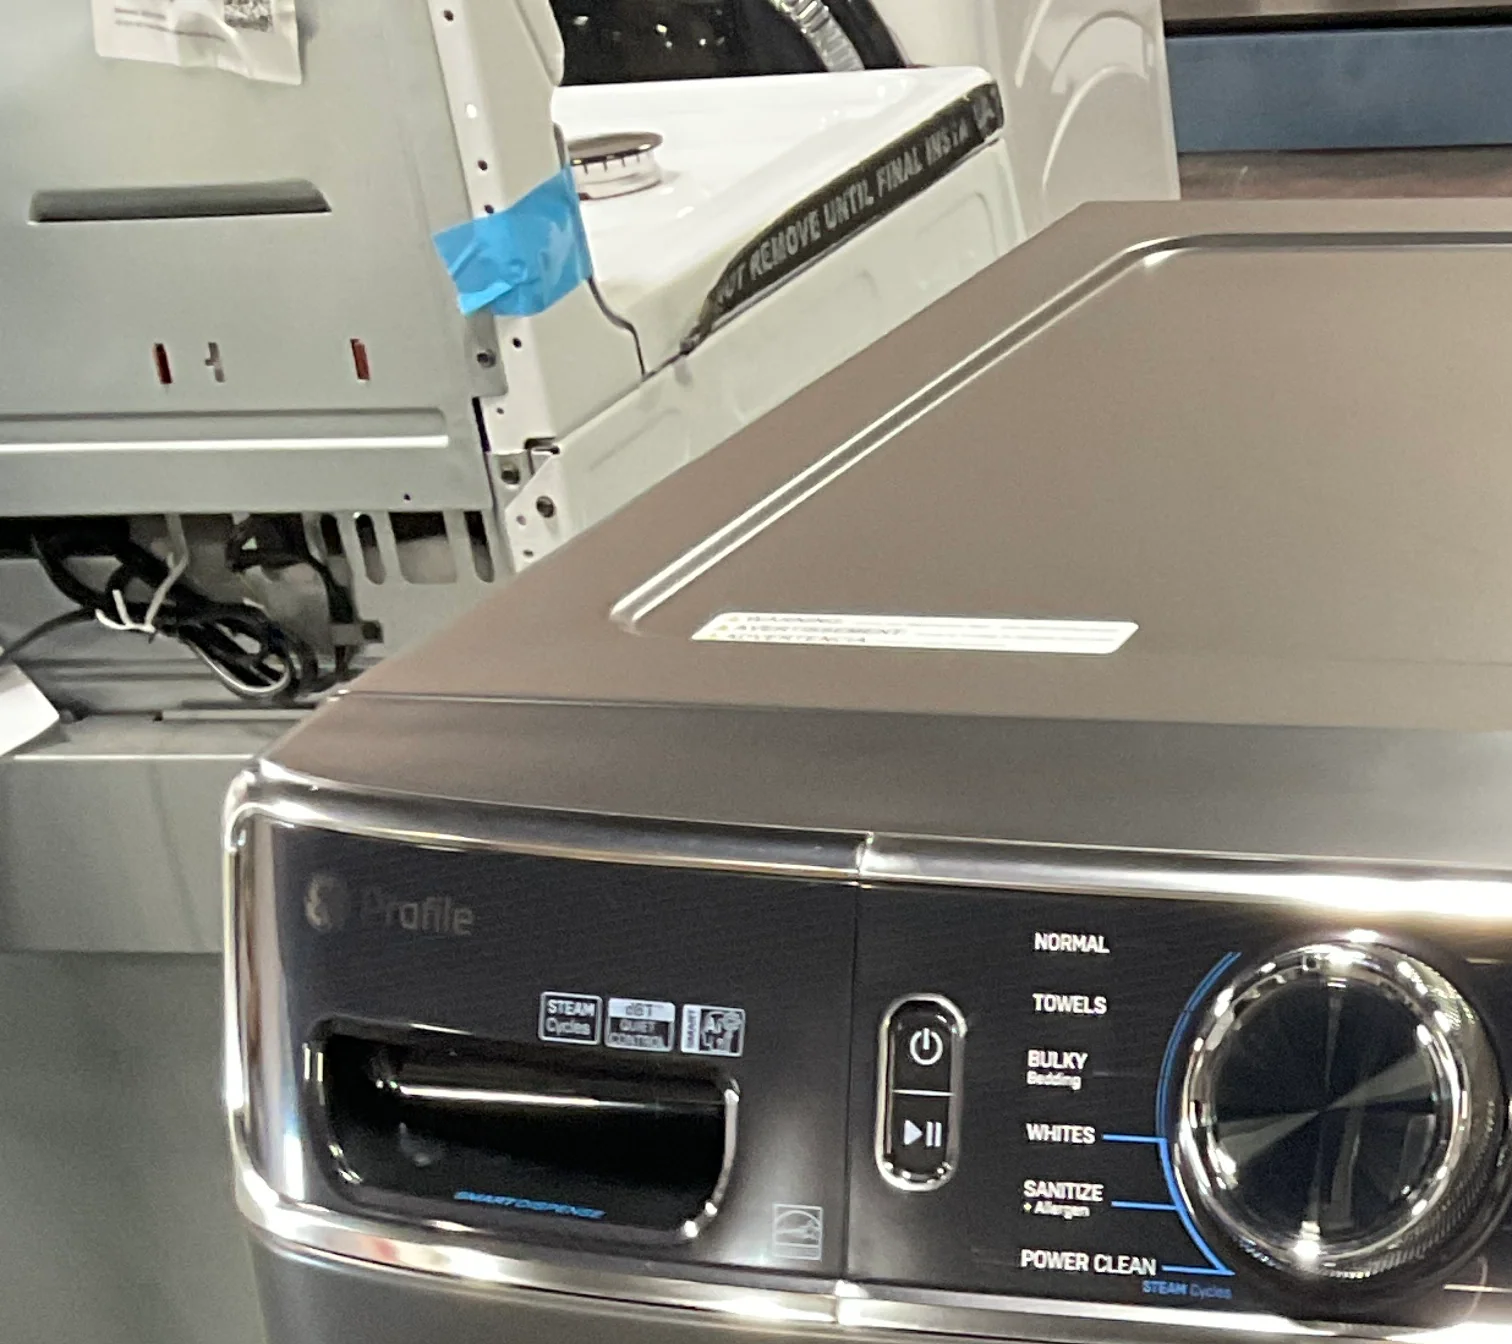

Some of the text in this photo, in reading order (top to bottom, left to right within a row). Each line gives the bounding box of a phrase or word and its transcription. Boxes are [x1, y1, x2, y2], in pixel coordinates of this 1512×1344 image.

[750, 210, 821, 281] REMOVE
[823, 180, 874, 231] UNTIL
[875, 147, 923, 198] FINAL
[1034, 932, 1110, 954] NORMAL
[547, 999, 595, 1017] STEAM
[1033, 993, 1107, 1015] TOWELS
[1027, 1050, 1088, 1069] BULKY
[1026, 1071, 1082, 1090] Bedding
[1026, 1122, 1096, 1144] WHITES
[1023, 1180, 1104, 1201] SANITIZE
[1020, 1249, 1157, 1276] POWER CLEAN
[1142, 1280, 1232, 1299] STEAM Cycles
